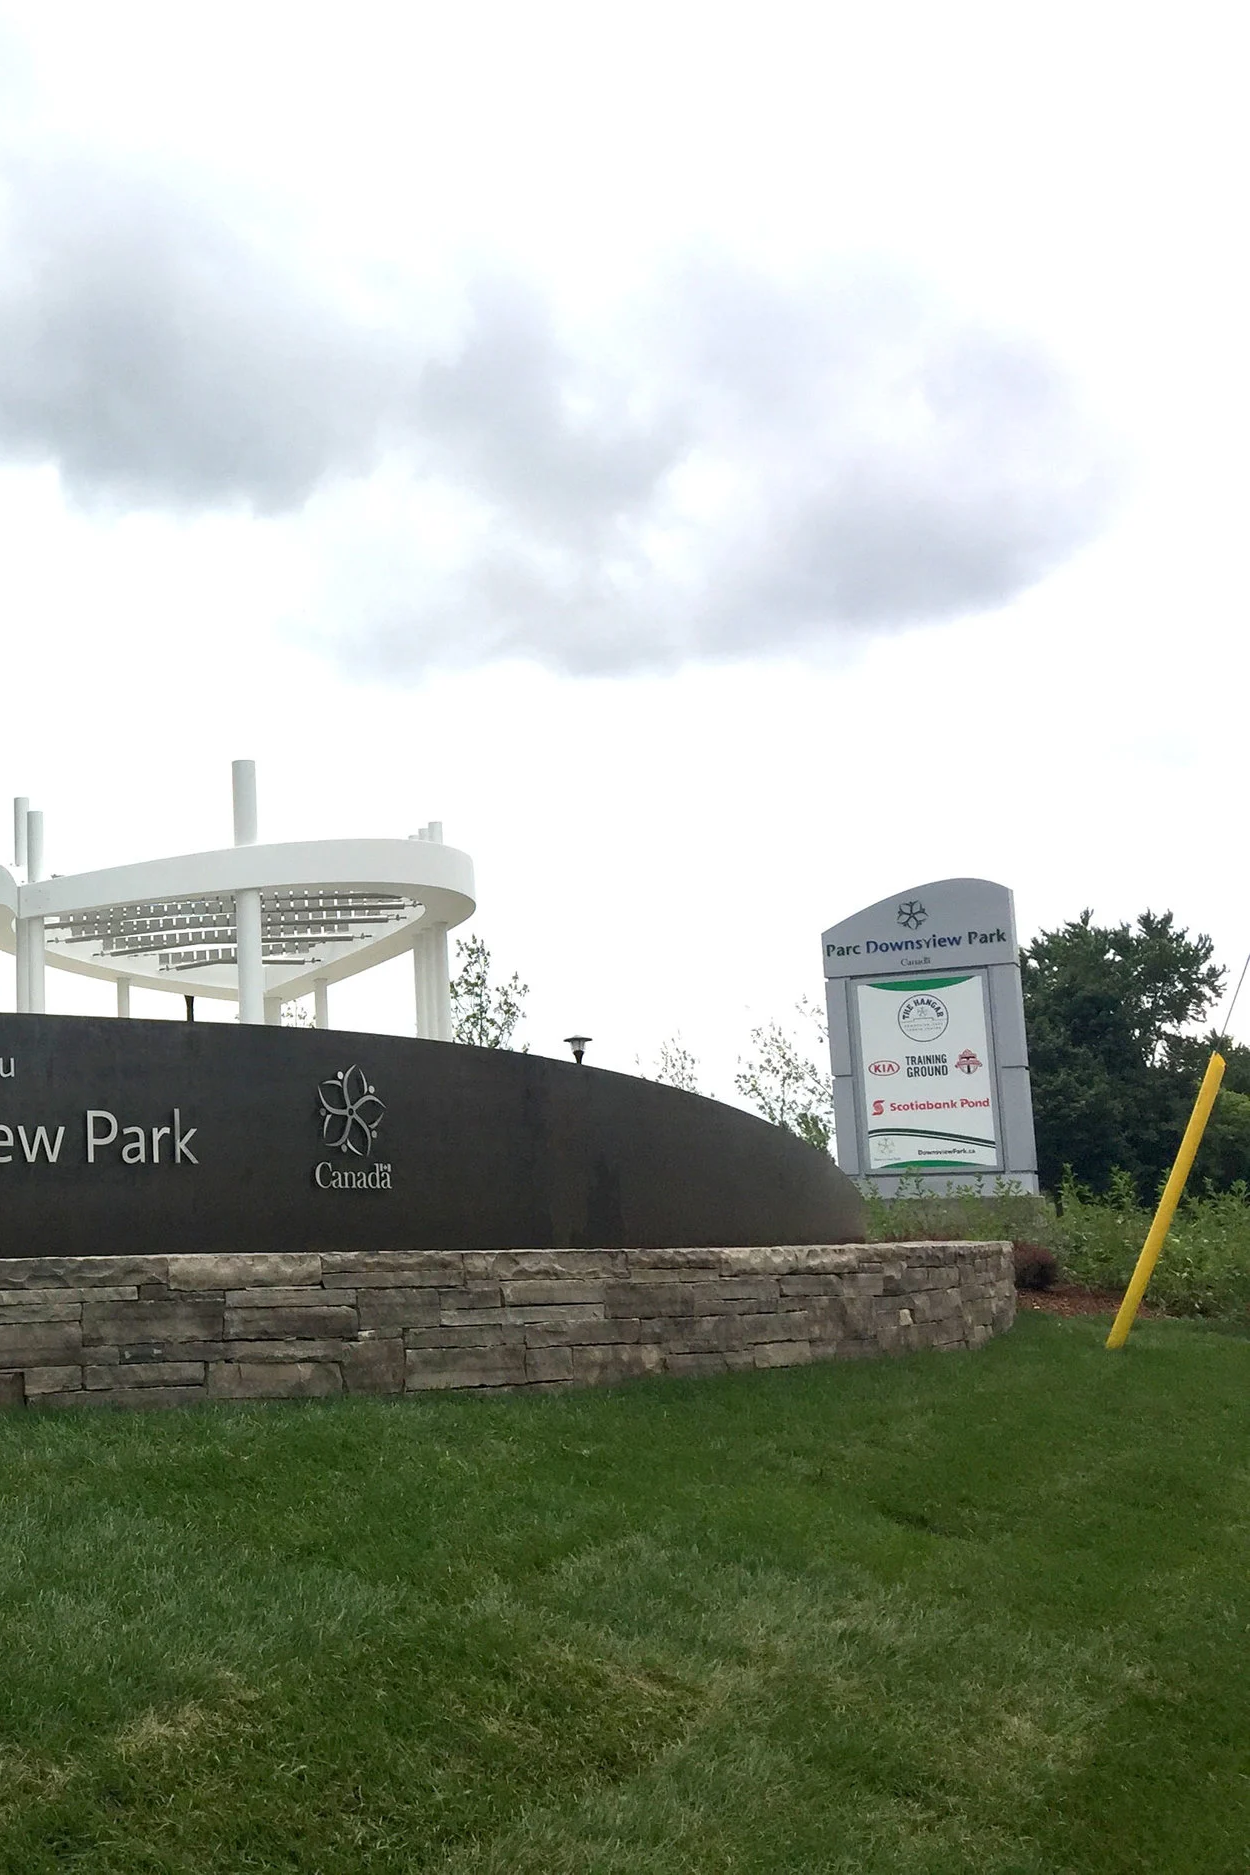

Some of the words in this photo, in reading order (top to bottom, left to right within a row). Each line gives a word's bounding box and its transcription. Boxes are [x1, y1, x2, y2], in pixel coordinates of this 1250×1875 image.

[826, 943, 861, 957] Parc
[866, 934, 962, 954] Downsview
[968, 928, 1007, 945] Park
[900, 956, 931, 966] Canada
[902, 1003, 914, 1020] THE
[913, 998, 944, 1018] HANGAR
[905, 1054, 948, 1066] TRAINING
[874, 1063, 895, 1073] KIA
[906, 1065, 949, 1078] GROUND
[890, 1099, 957, 1112] Scotiabank
[959, 1098, 990, 1109] Pond
[86, 1107, 199, 1166] Park
[315, 1161, 392, 1189] Canada
